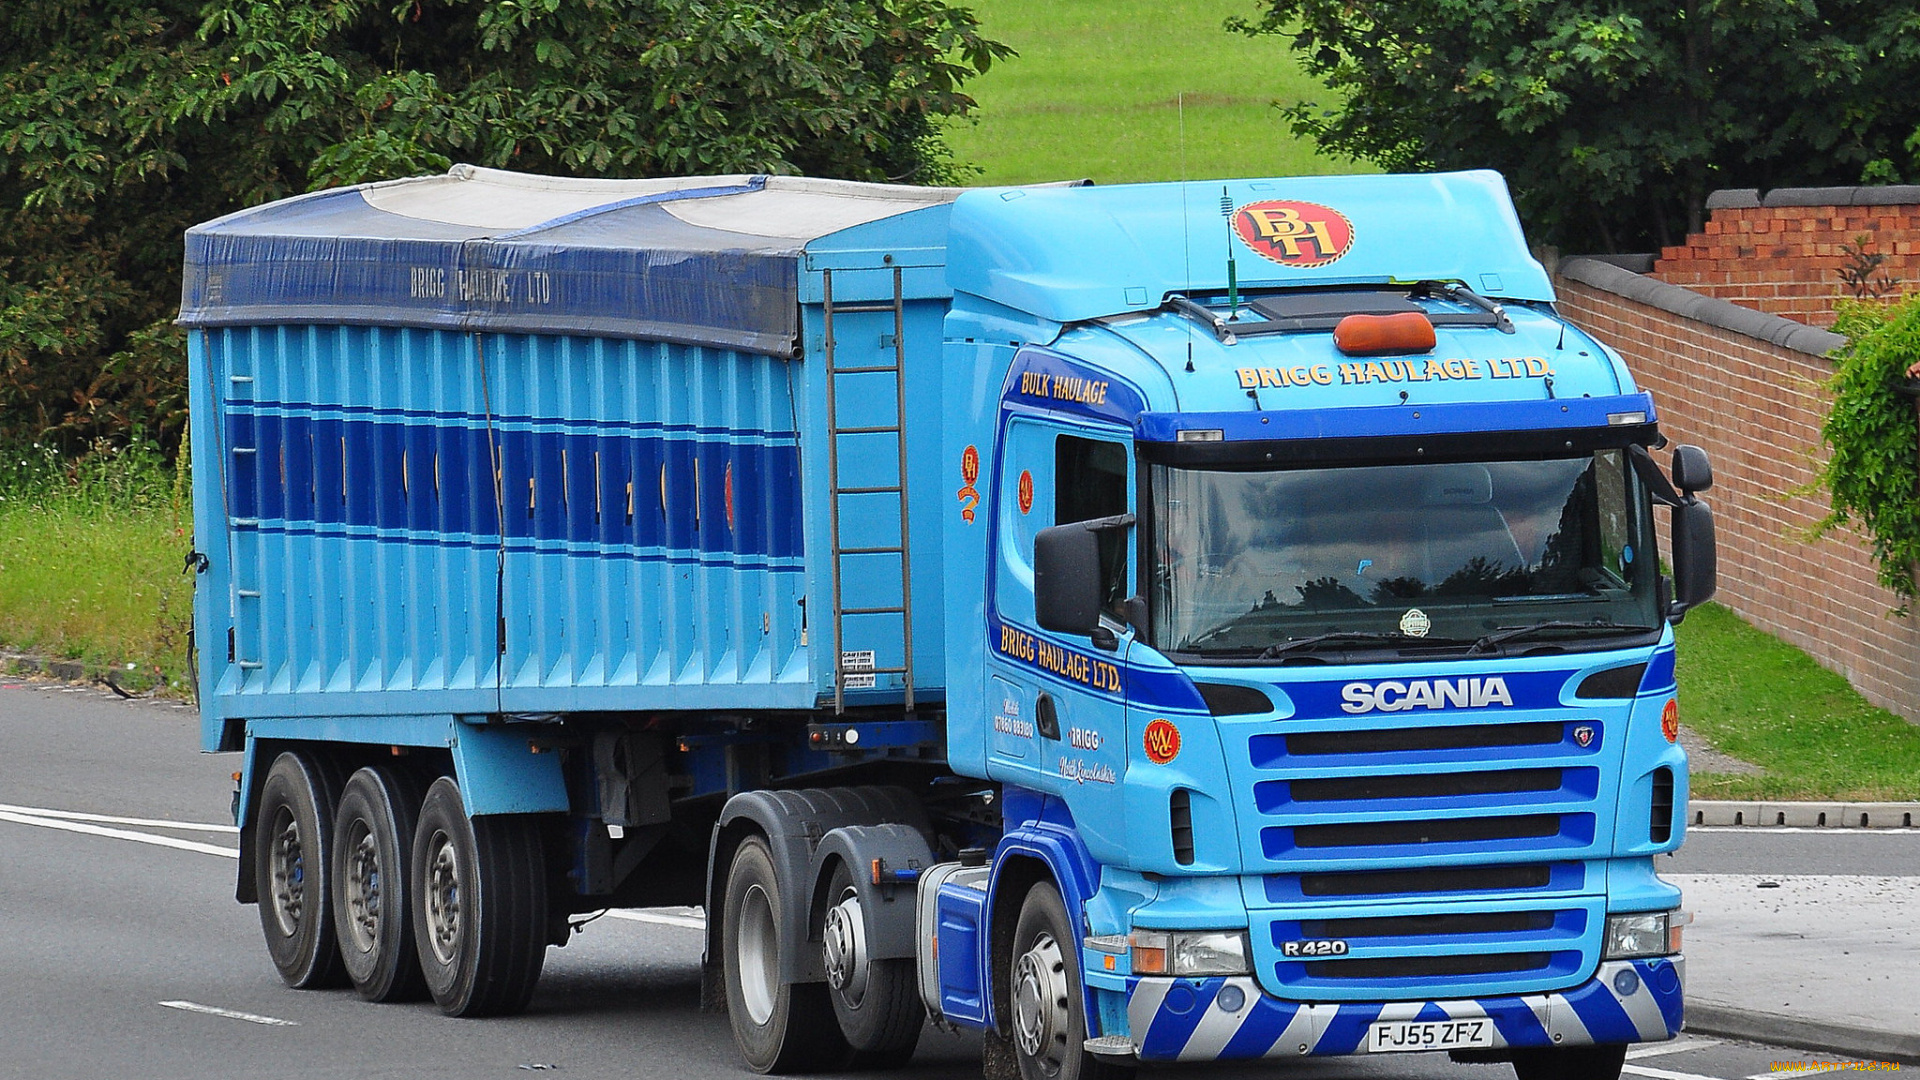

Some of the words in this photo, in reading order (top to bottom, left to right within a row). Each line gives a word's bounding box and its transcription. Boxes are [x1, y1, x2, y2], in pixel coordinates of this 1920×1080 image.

[410, 267, 445, 299] BRIGG
[527, 272, 550, 304] LTD
[1021, 371, 1051, 397] BULK
[1053, 375, 1109, 405] HAULAGE
[1238, 364, 1332, 390] BRIGG
[1339, 359, 1482, 384] HAULAGE
[1487, 356, 1556, 378] LTD.
[1000, 624, 1035, 662] BRIGG
[1037, 640, 1090, 683] HAULAGE
[1092, 660, 1122, 693] LTD.
[1340, 677, 1514, 714] SCANIA
[1284, 942, 1299, 956] R
[1302, 940, 1346, 955] 420
[1378, 1025, 1435, 1047] FJ55
[1441, 1022, 1484, 1044] ZFZ
